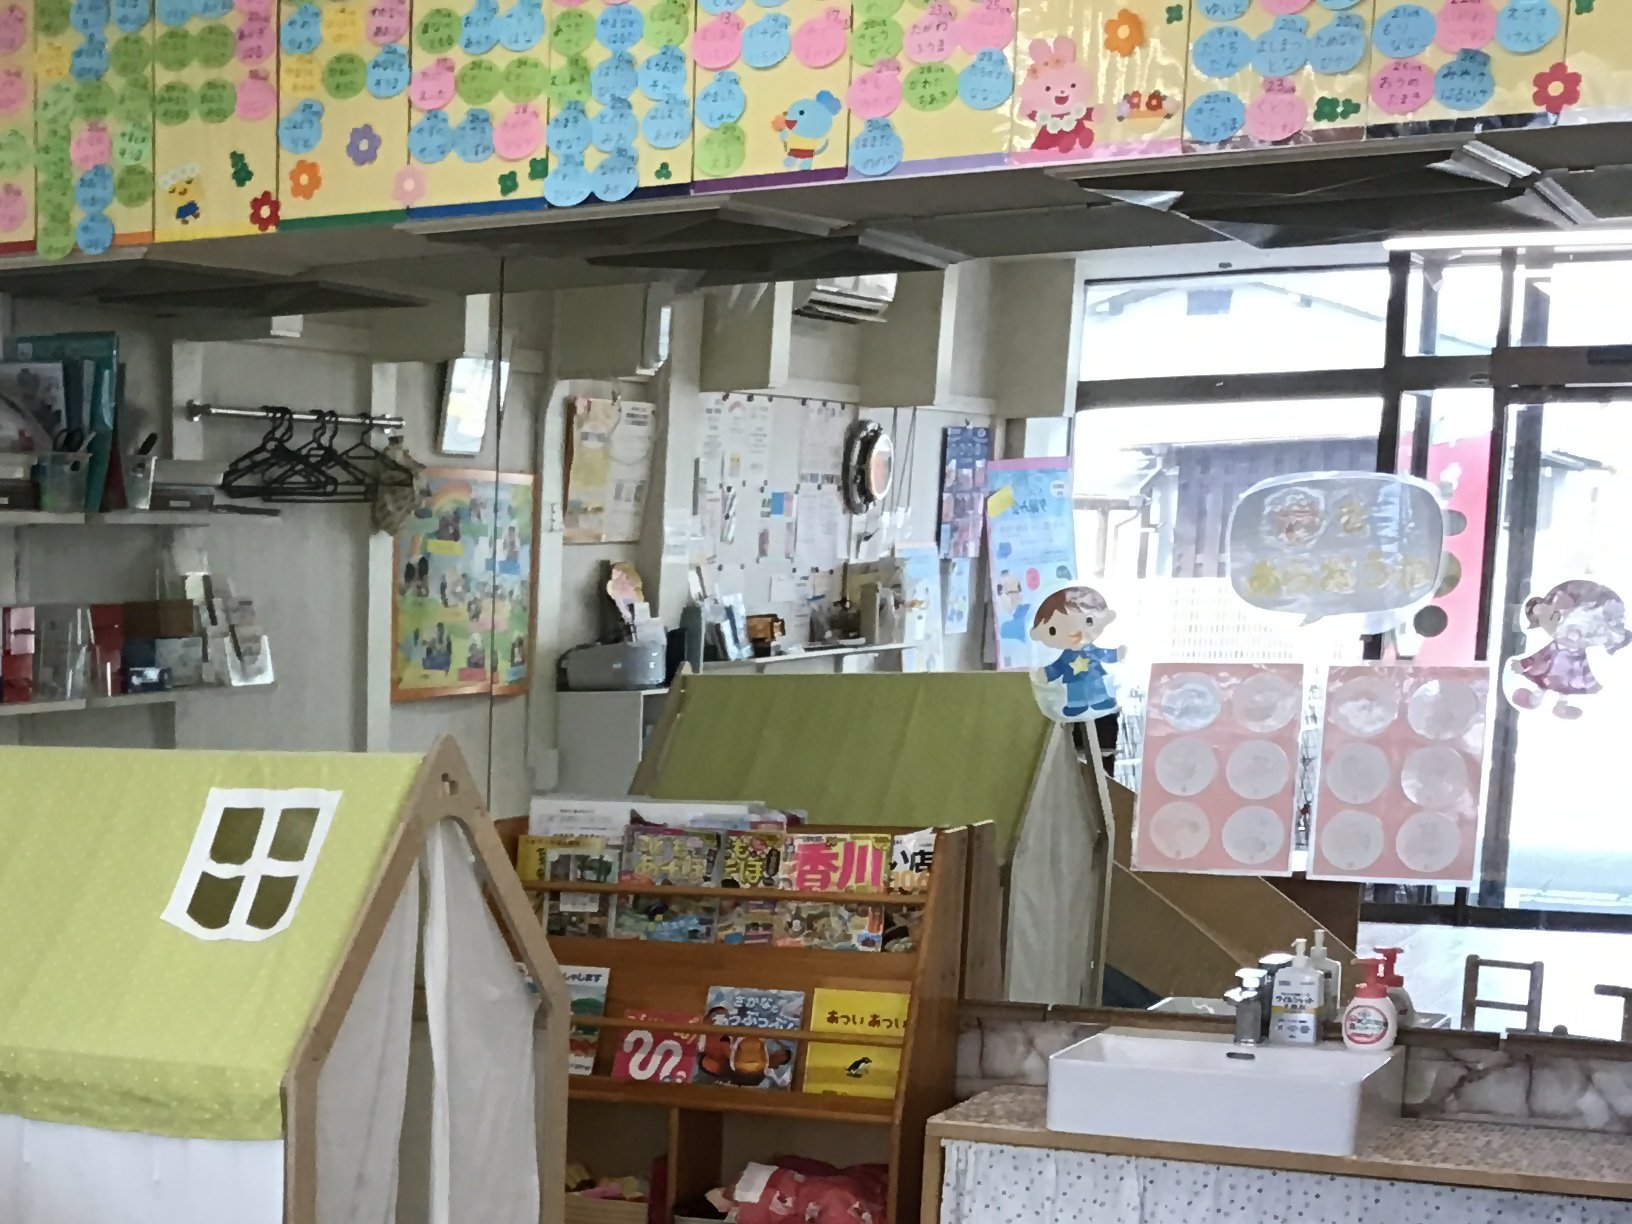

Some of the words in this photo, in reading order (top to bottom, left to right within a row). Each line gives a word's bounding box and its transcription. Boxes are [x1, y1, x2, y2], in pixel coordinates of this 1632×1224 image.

[793, 841, 884, 891] 香川
[826, 1009, 864, 1026] あつい
